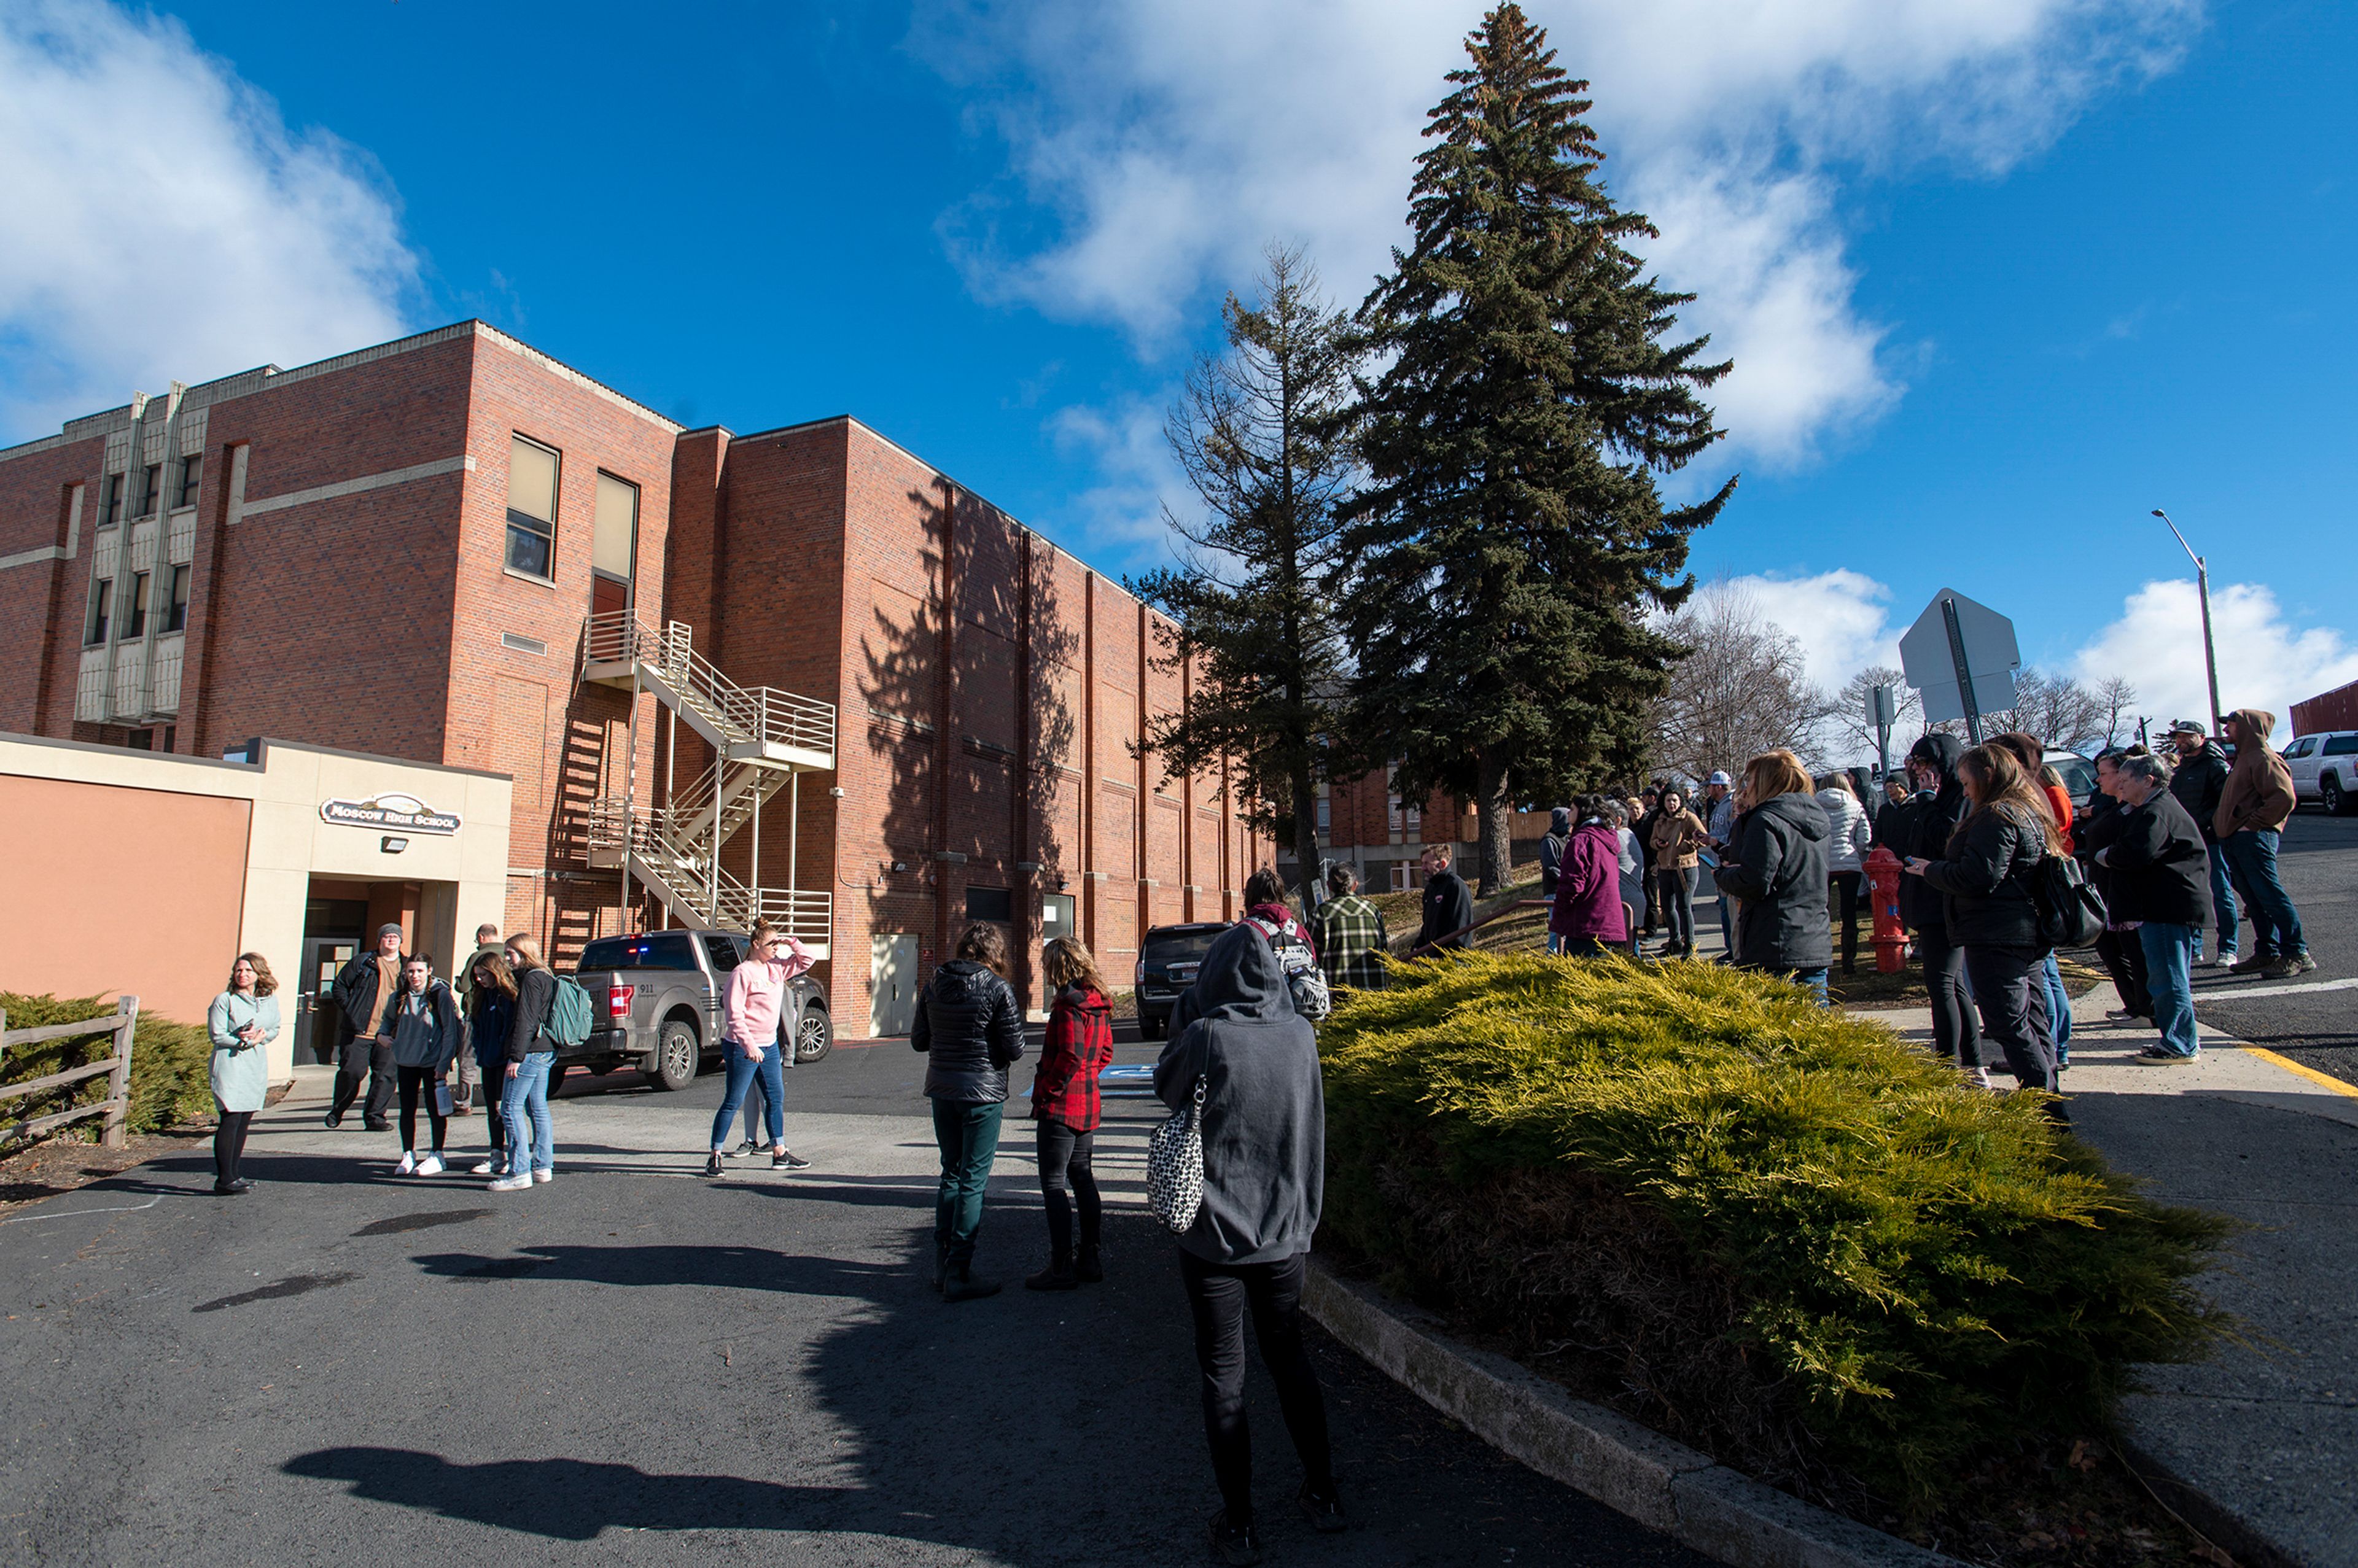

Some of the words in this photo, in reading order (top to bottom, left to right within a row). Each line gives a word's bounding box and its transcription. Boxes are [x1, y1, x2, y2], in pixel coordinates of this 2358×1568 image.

[331, 805, 383, 820] MOSCOW
[385, 812, 413, 824] HIGH
[414, 815, 455, 828] SCHOOL
[640, 984, 653, 993] 911
